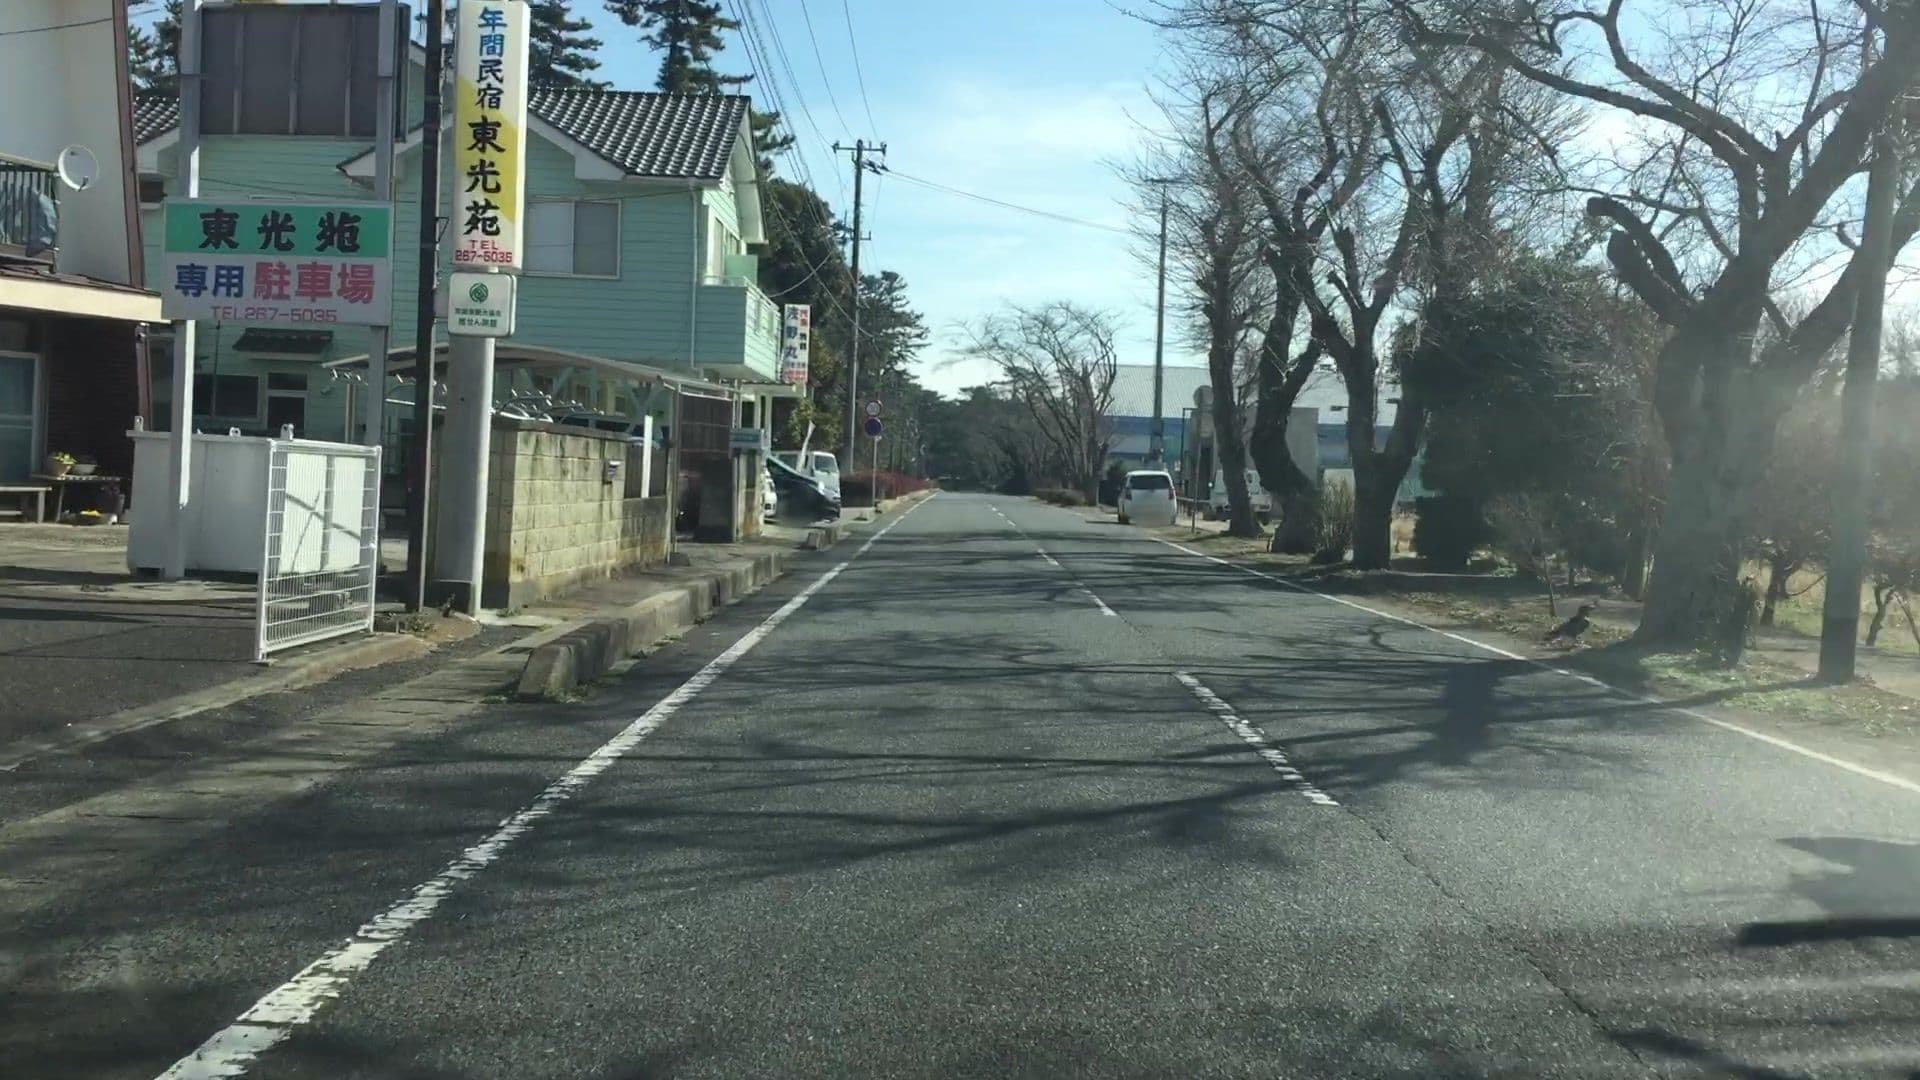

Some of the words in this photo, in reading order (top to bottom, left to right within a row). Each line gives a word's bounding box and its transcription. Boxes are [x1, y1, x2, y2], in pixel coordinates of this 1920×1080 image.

[475, 7, 507, 110] 年間民宿
[464, 116, 506, 237] 東光苑
[455, 250, 513, 263] 267-5035
[470, 240, 499, 250] TEL
